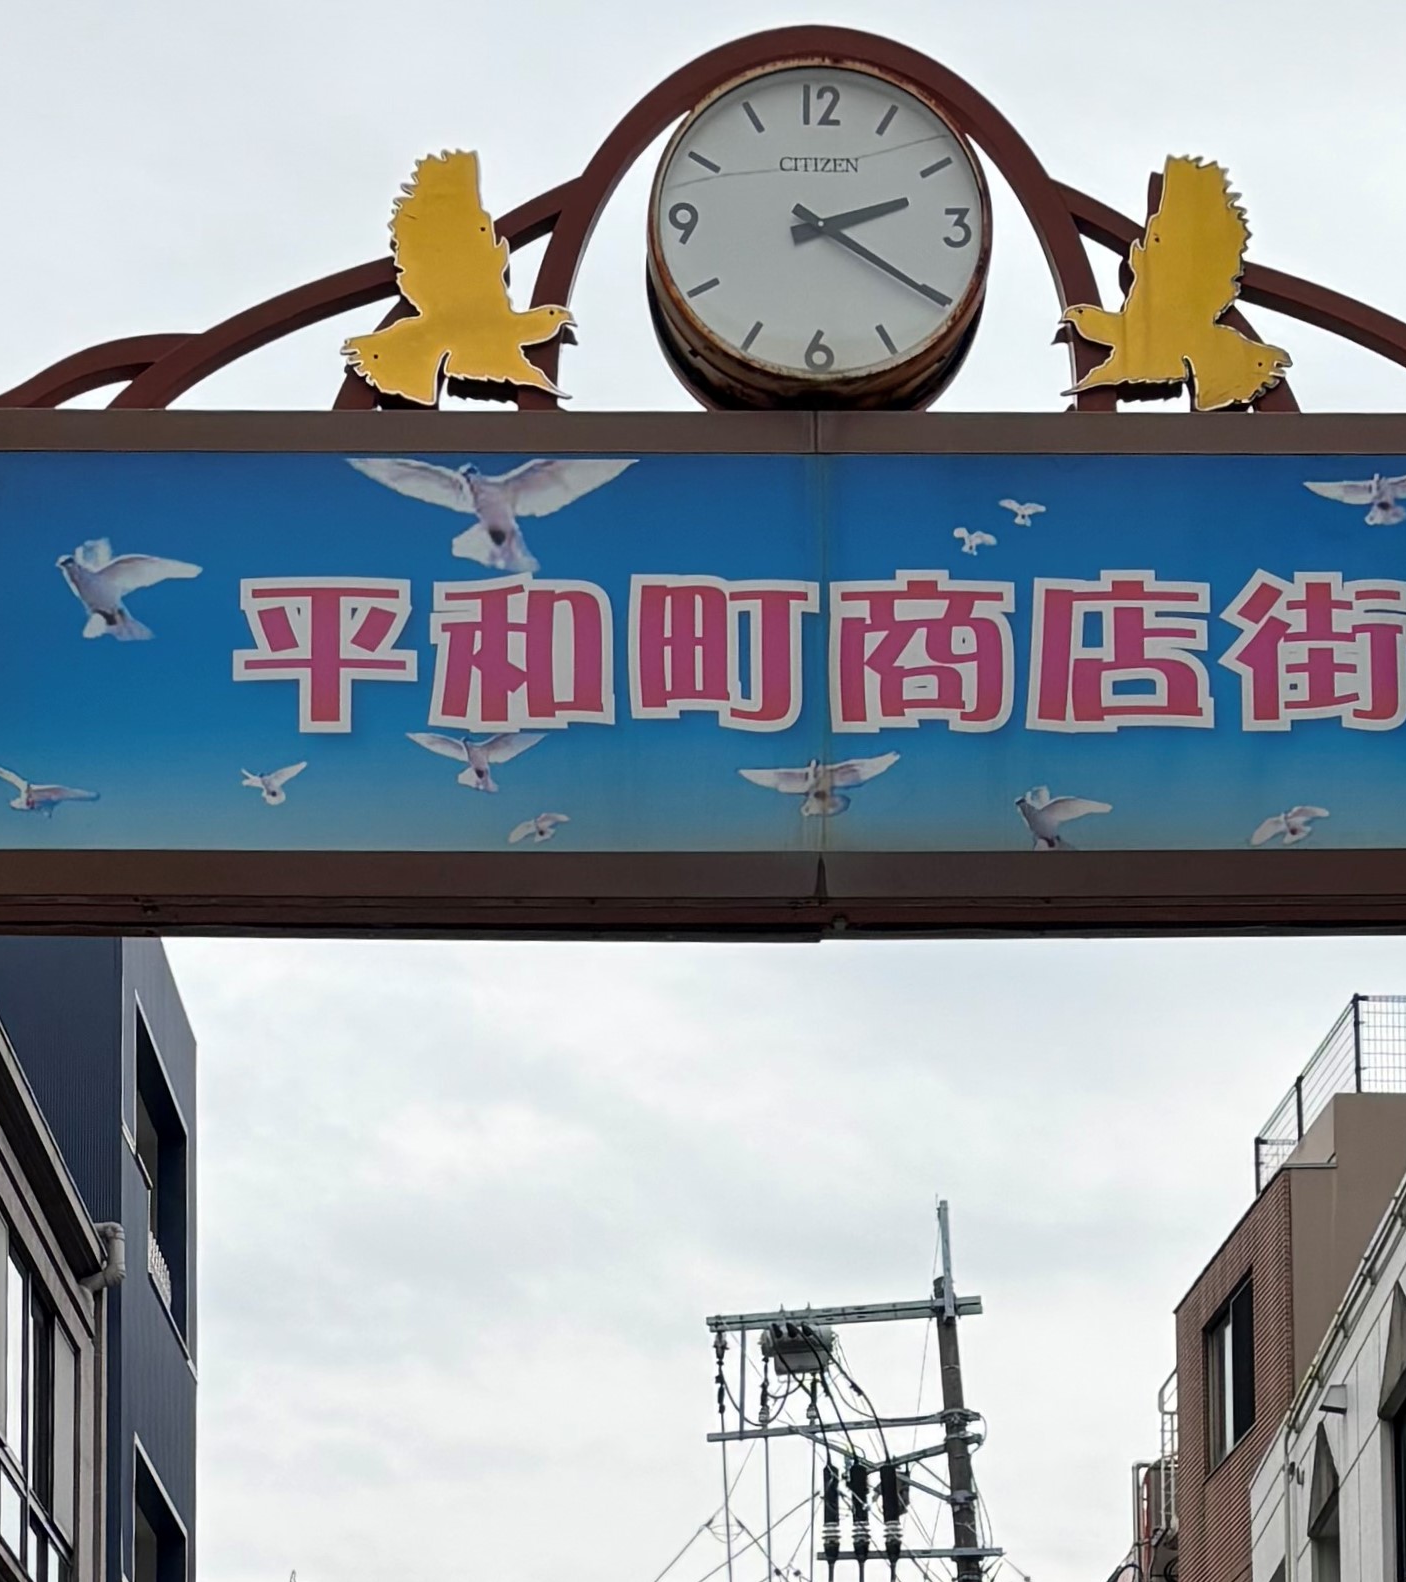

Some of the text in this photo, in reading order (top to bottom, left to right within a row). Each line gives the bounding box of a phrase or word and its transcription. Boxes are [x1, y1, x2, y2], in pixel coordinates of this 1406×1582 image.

[803, 84, 841, 126] 12
[779, 156, 860, 174] CITIZEN
[668, 202, 699, 245] 9
[942, 207, 972, 249] 3
[804, 329, 835, 371] 6
